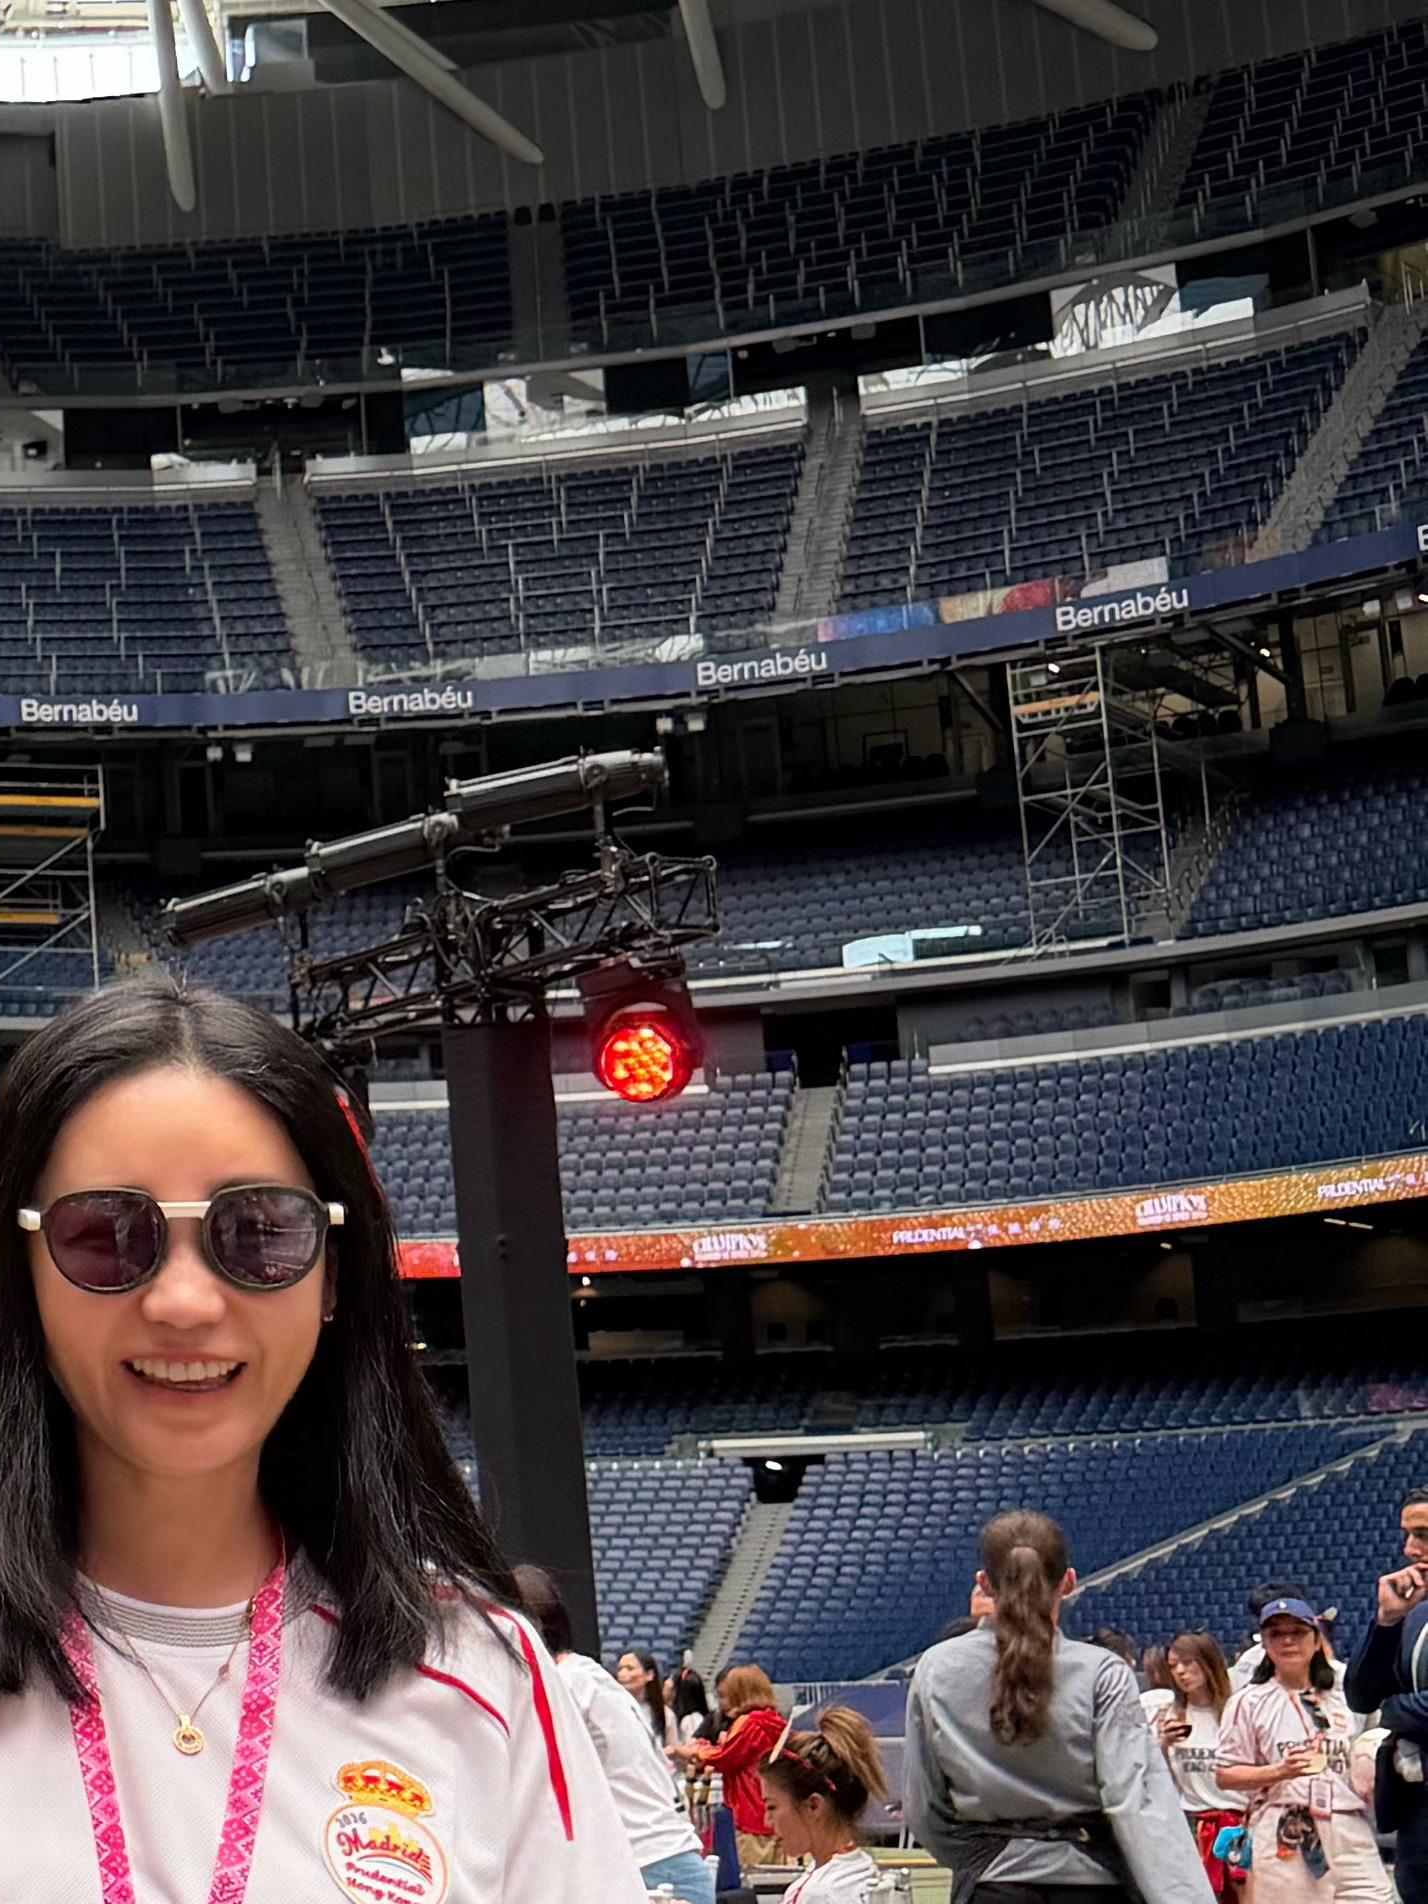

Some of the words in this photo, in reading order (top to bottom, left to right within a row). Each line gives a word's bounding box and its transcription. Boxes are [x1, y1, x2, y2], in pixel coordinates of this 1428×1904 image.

[1055, 586, 1190, 632] Bernabéu
[696, 649, 828, 687] Bernabéu
[21, 698, 138, 723] Bernabéu
[348, 688, 474, 715] Bernabéu
